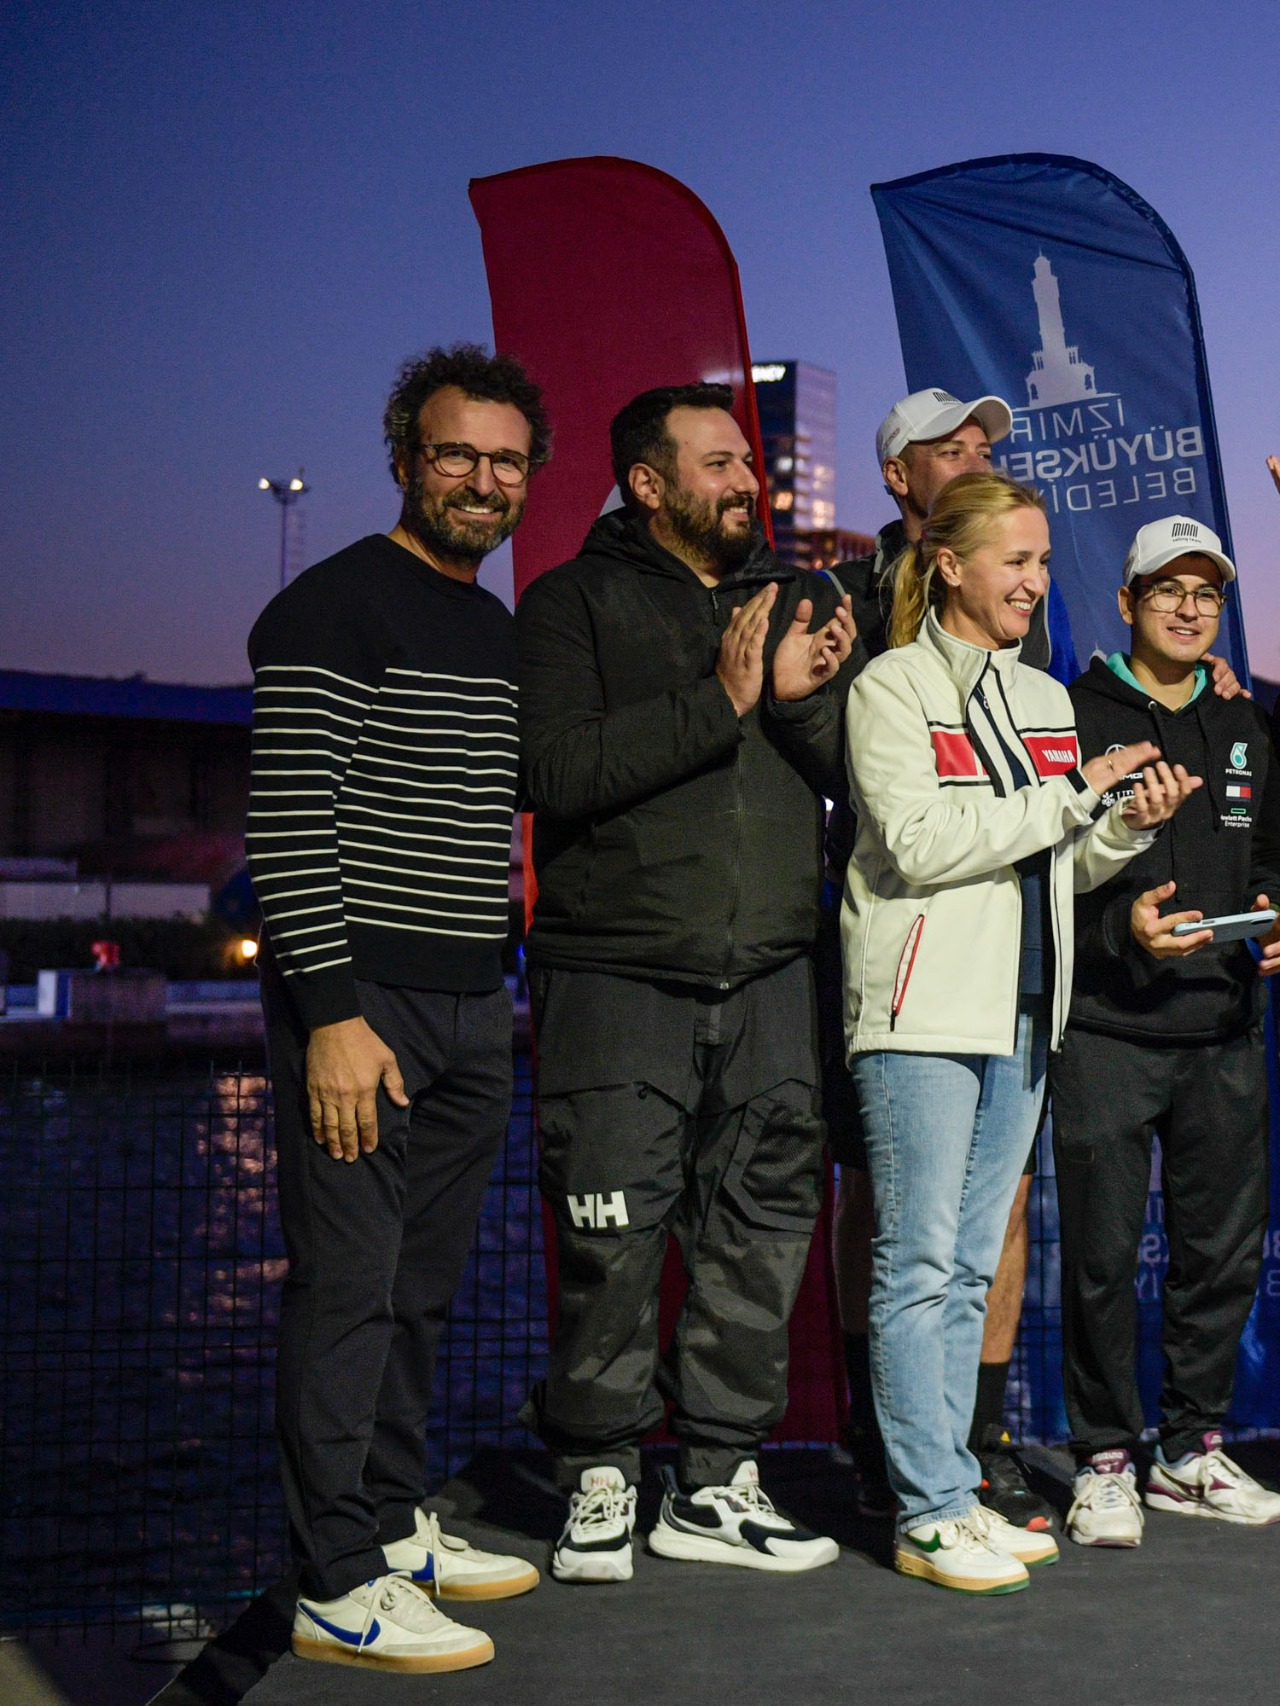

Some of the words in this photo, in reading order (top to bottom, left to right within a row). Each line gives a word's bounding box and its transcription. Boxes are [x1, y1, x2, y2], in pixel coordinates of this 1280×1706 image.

[1041, 749, 1076, 763] YAMAHA
[1119, 772, 1144, 780] MG
[566, 1190, 630, 1229] HH
